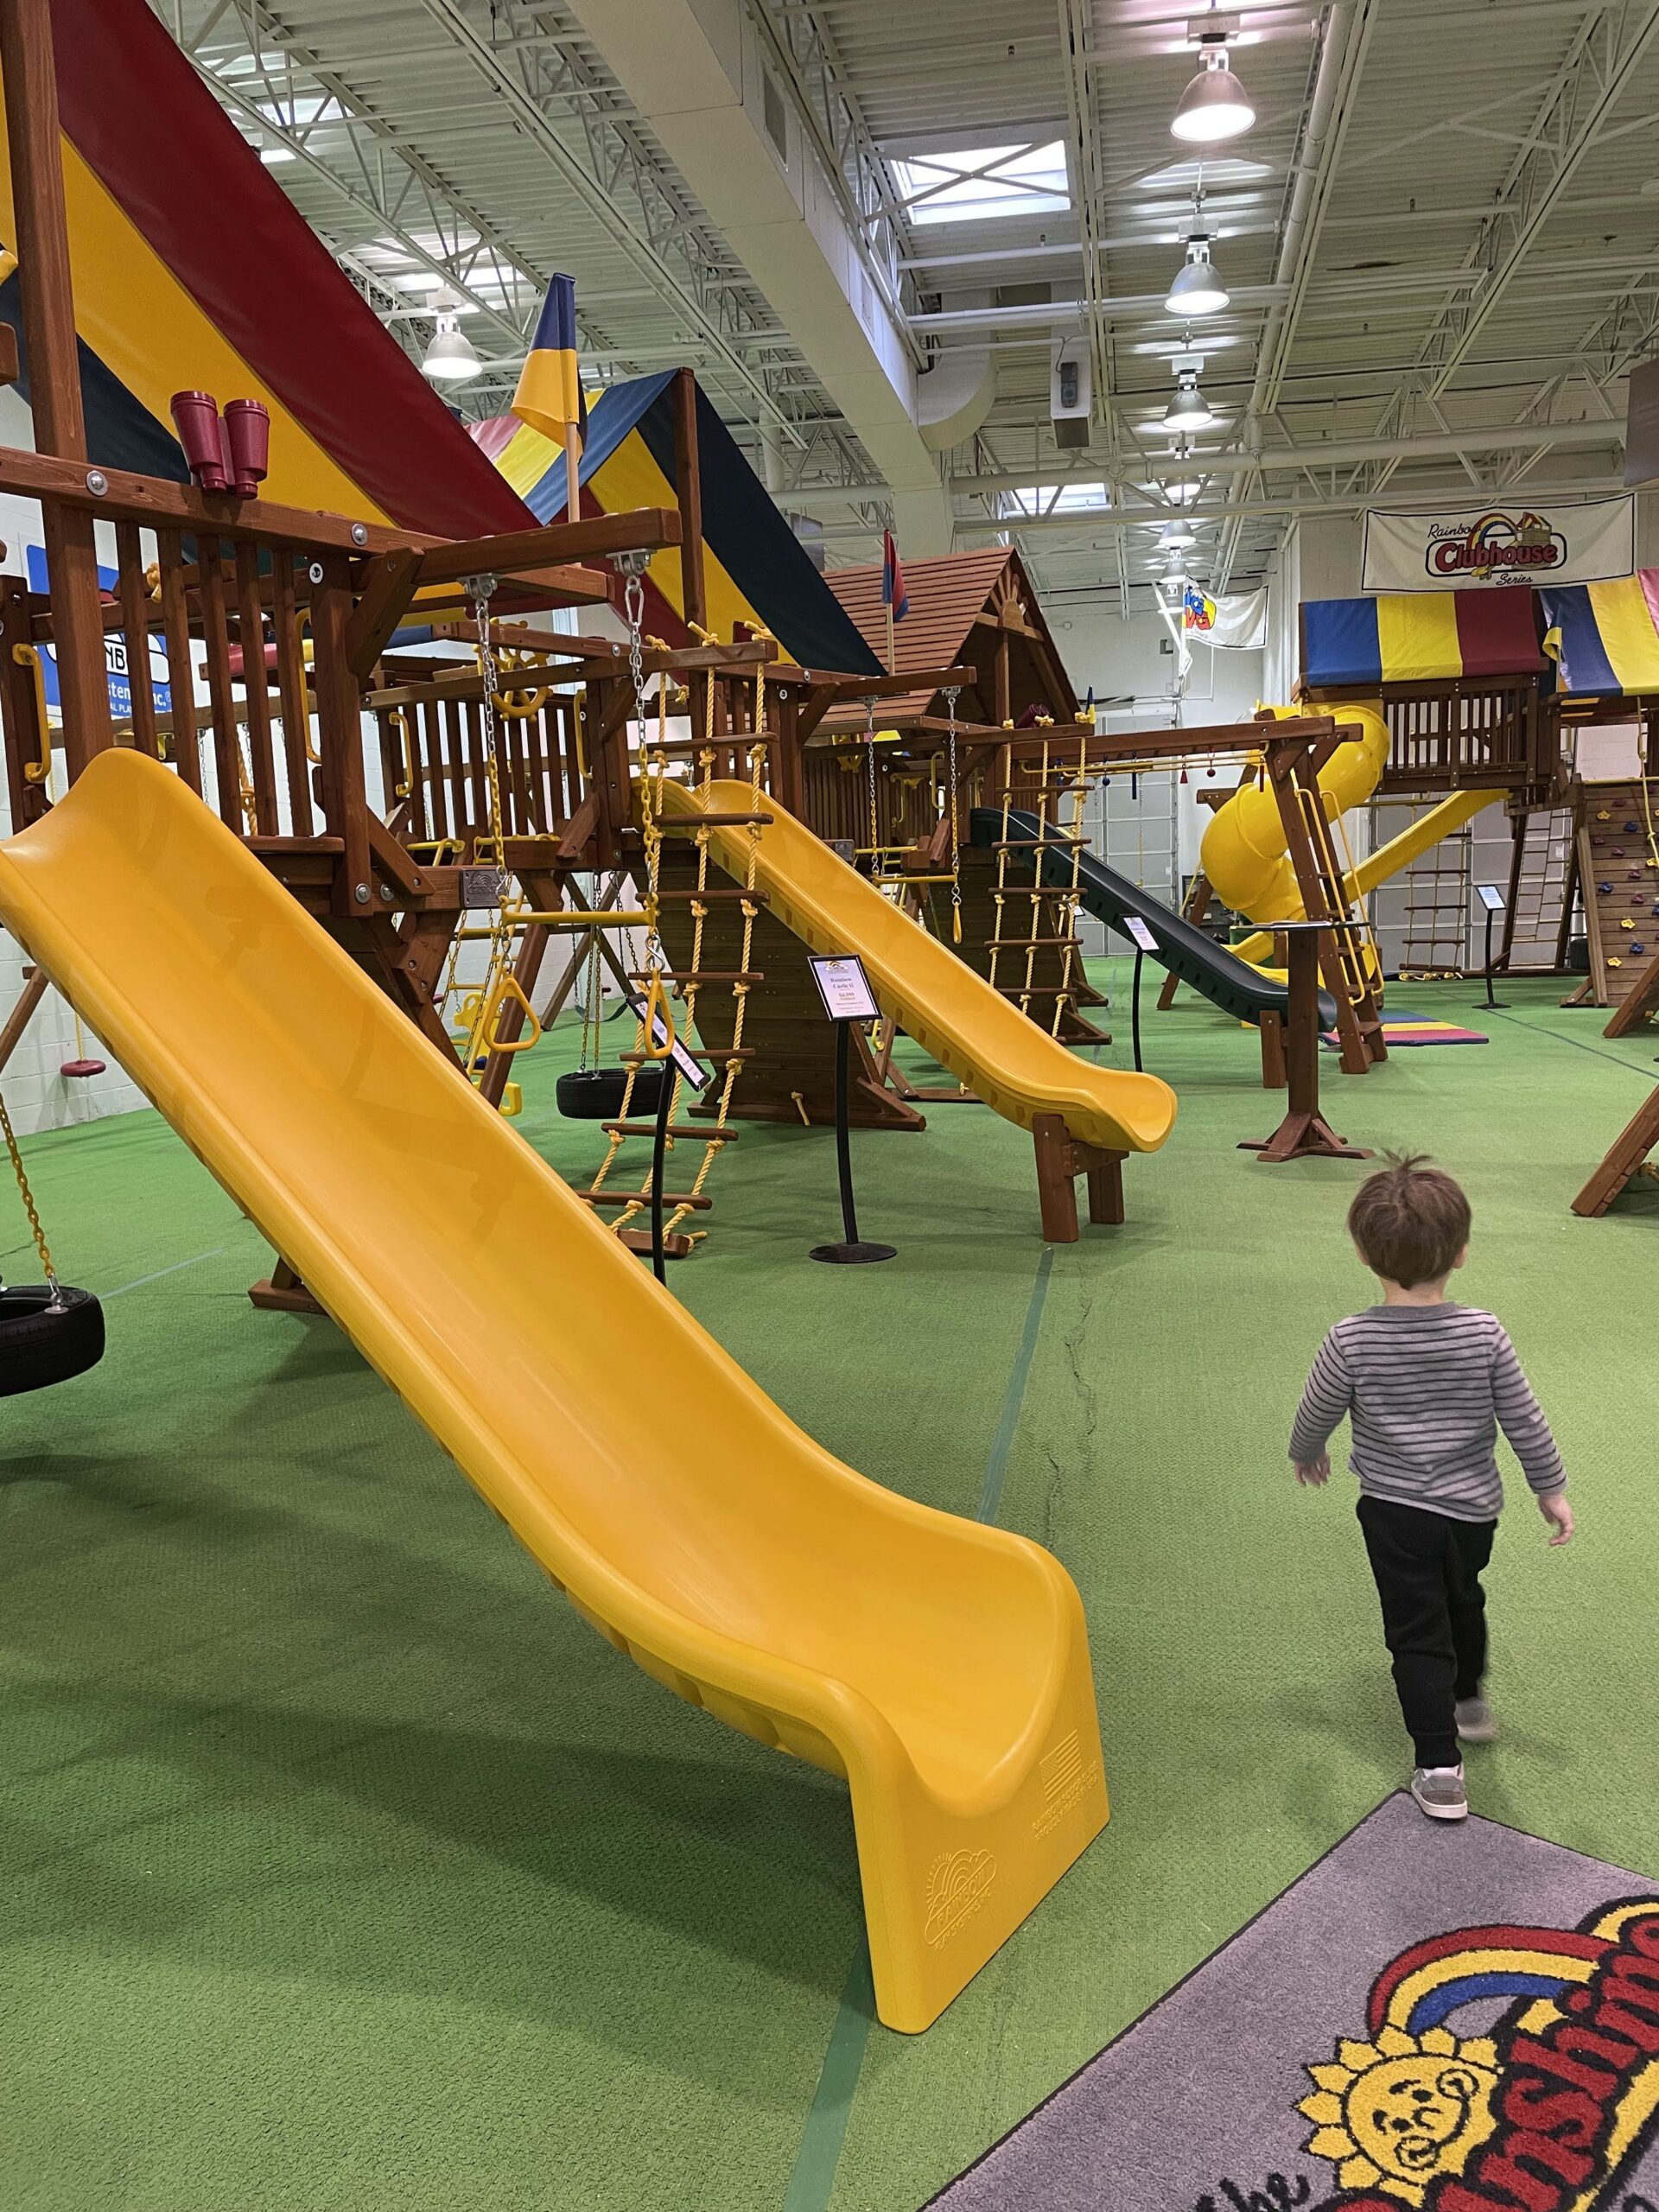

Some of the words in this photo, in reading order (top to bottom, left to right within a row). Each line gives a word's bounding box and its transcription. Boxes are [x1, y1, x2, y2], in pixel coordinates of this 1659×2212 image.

[1434, 541, 1558, 573] Clubhouse
[1496, 573, 1533, 586] Series
[937, 1867, 988, 1928] RAINBOW
